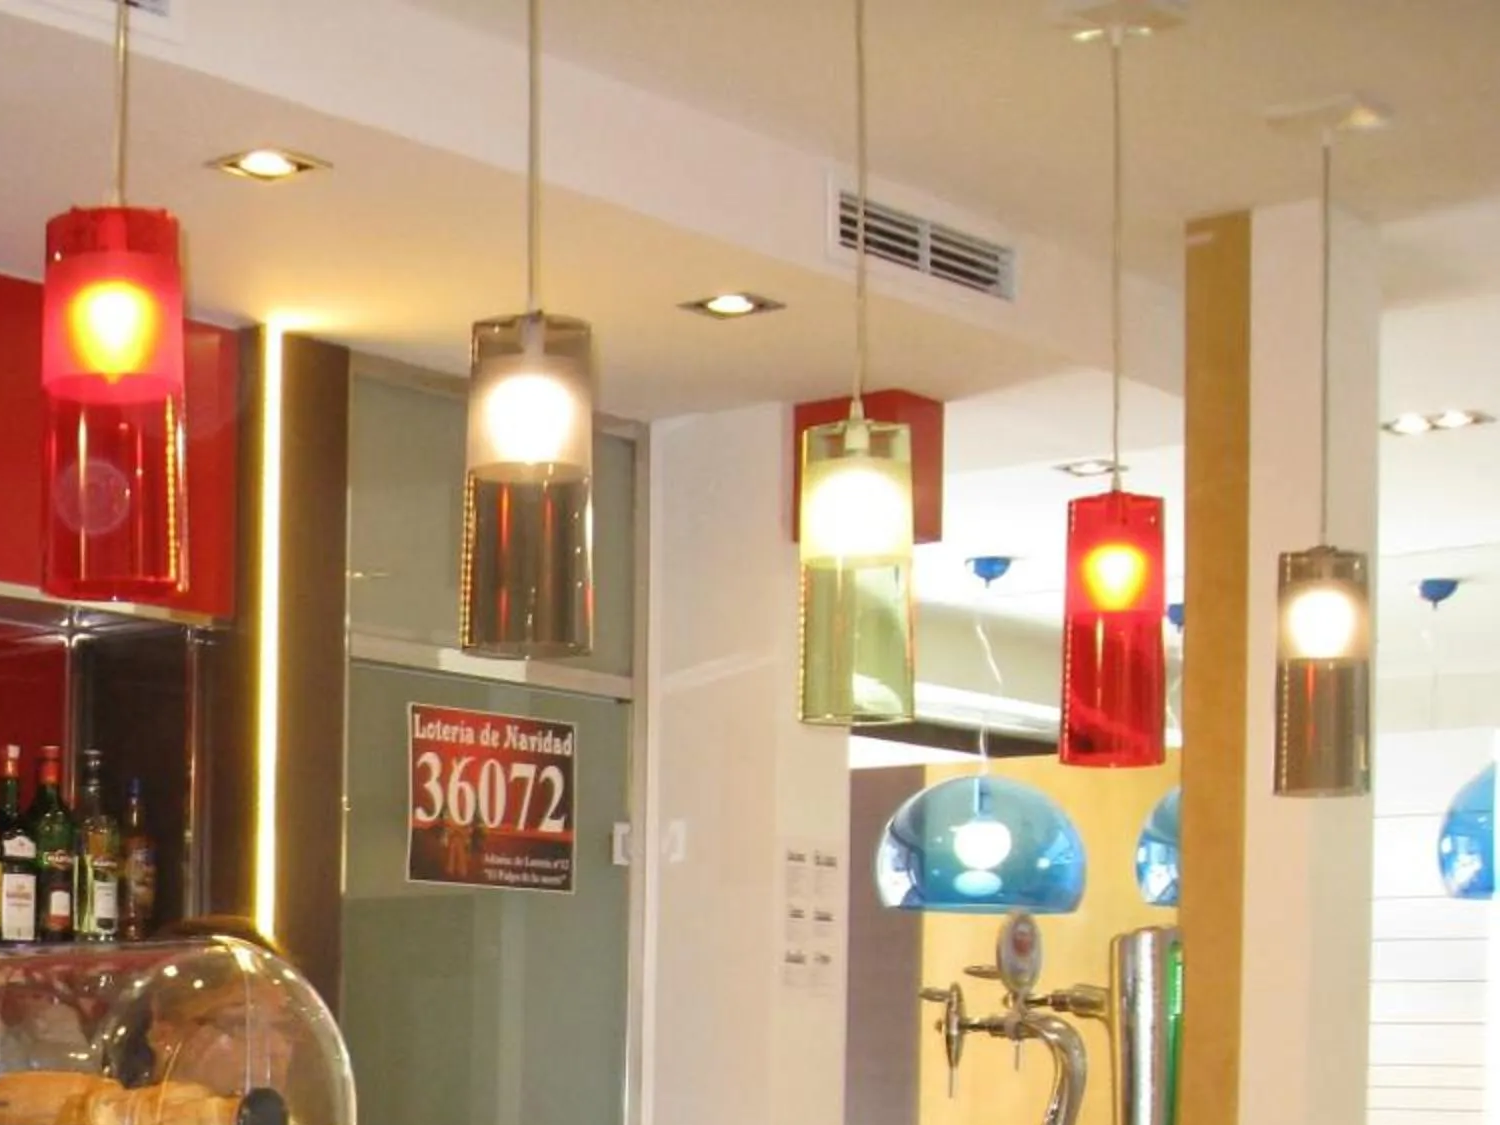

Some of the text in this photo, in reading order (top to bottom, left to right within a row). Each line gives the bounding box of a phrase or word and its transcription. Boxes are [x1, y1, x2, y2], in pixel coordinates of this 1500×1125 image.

[480, 722, 499, 747] de
[504, 725, 572, 756] Navidad
[415, 751, 566, 832] 36072
